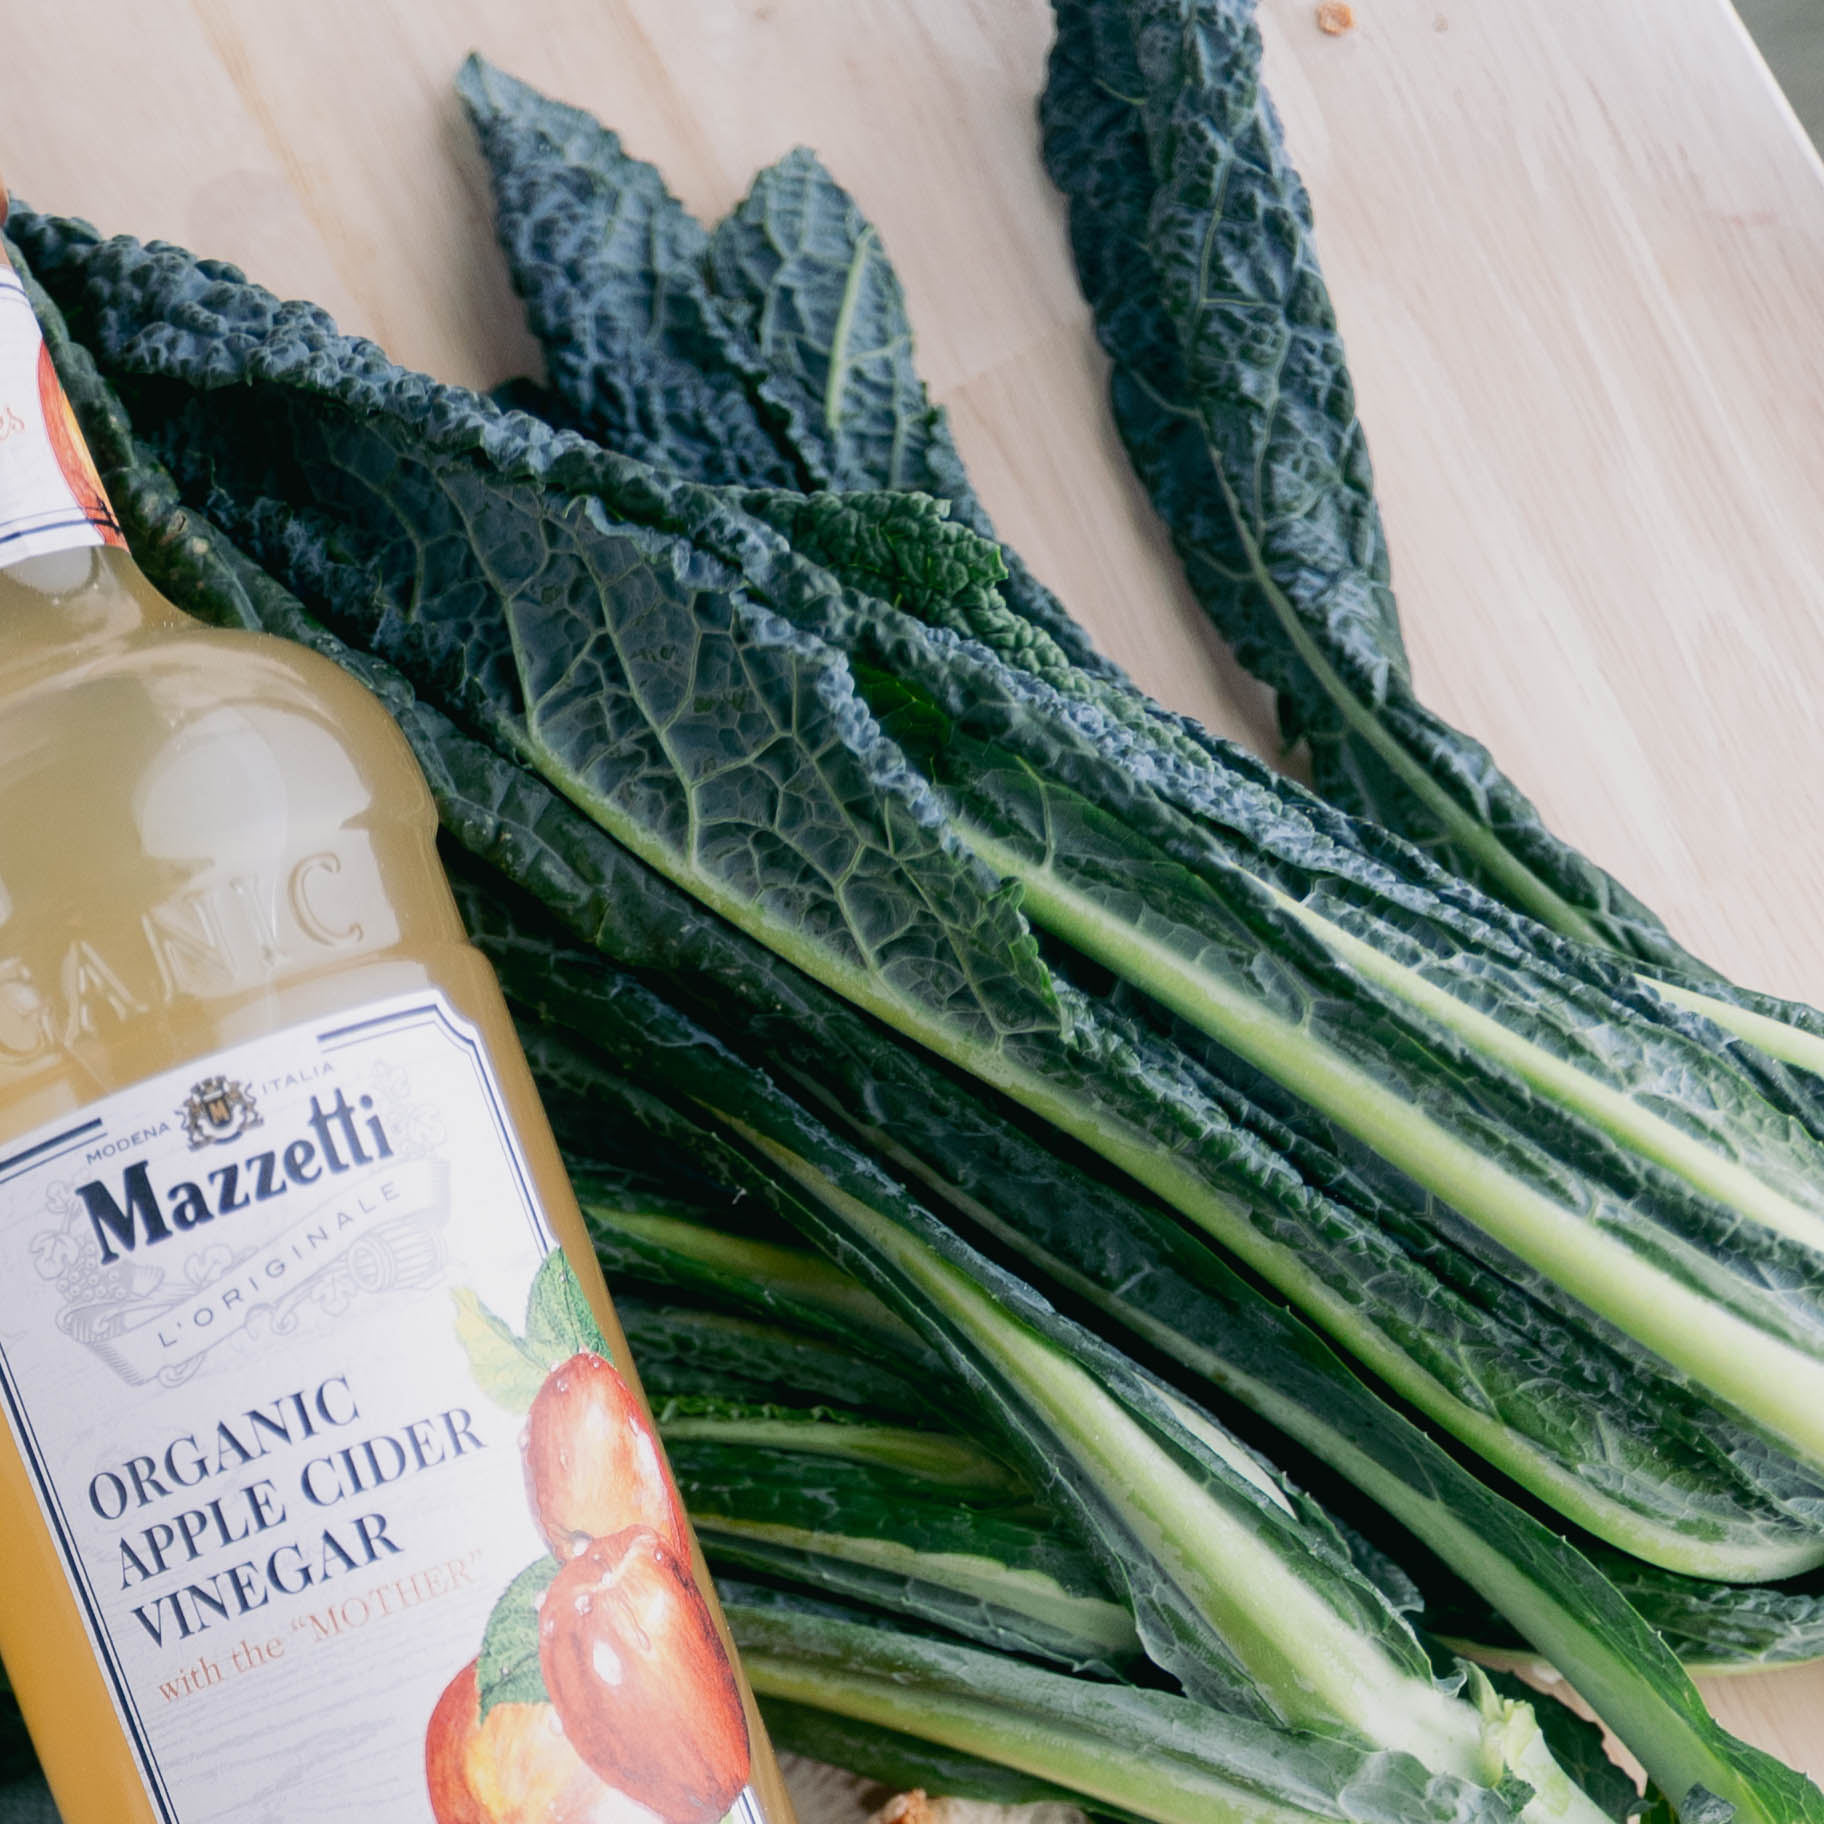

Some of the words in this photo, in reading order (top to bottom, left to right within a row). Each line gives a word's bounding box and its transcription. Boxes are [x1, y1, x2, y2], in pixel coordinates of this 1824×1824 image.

[75, 1087, 393, 1265] Mazzetti
[86, 1122, 170, 1165] MODENA
[262, 1061, 334, 1094] ITALIA
[158, 1182, 400, 1348] L'ORIGINALE
[88, 1376, 360, 1521] ORGANIC
[120, 1479, 287, 1591] APPLE
[300, 1408, 486, 1507] CIDER
[131, 1513, 404, 1648] VINEGAR
[158, 1657, 224, 1704] with
[232, 1639, 286, 1674] the
